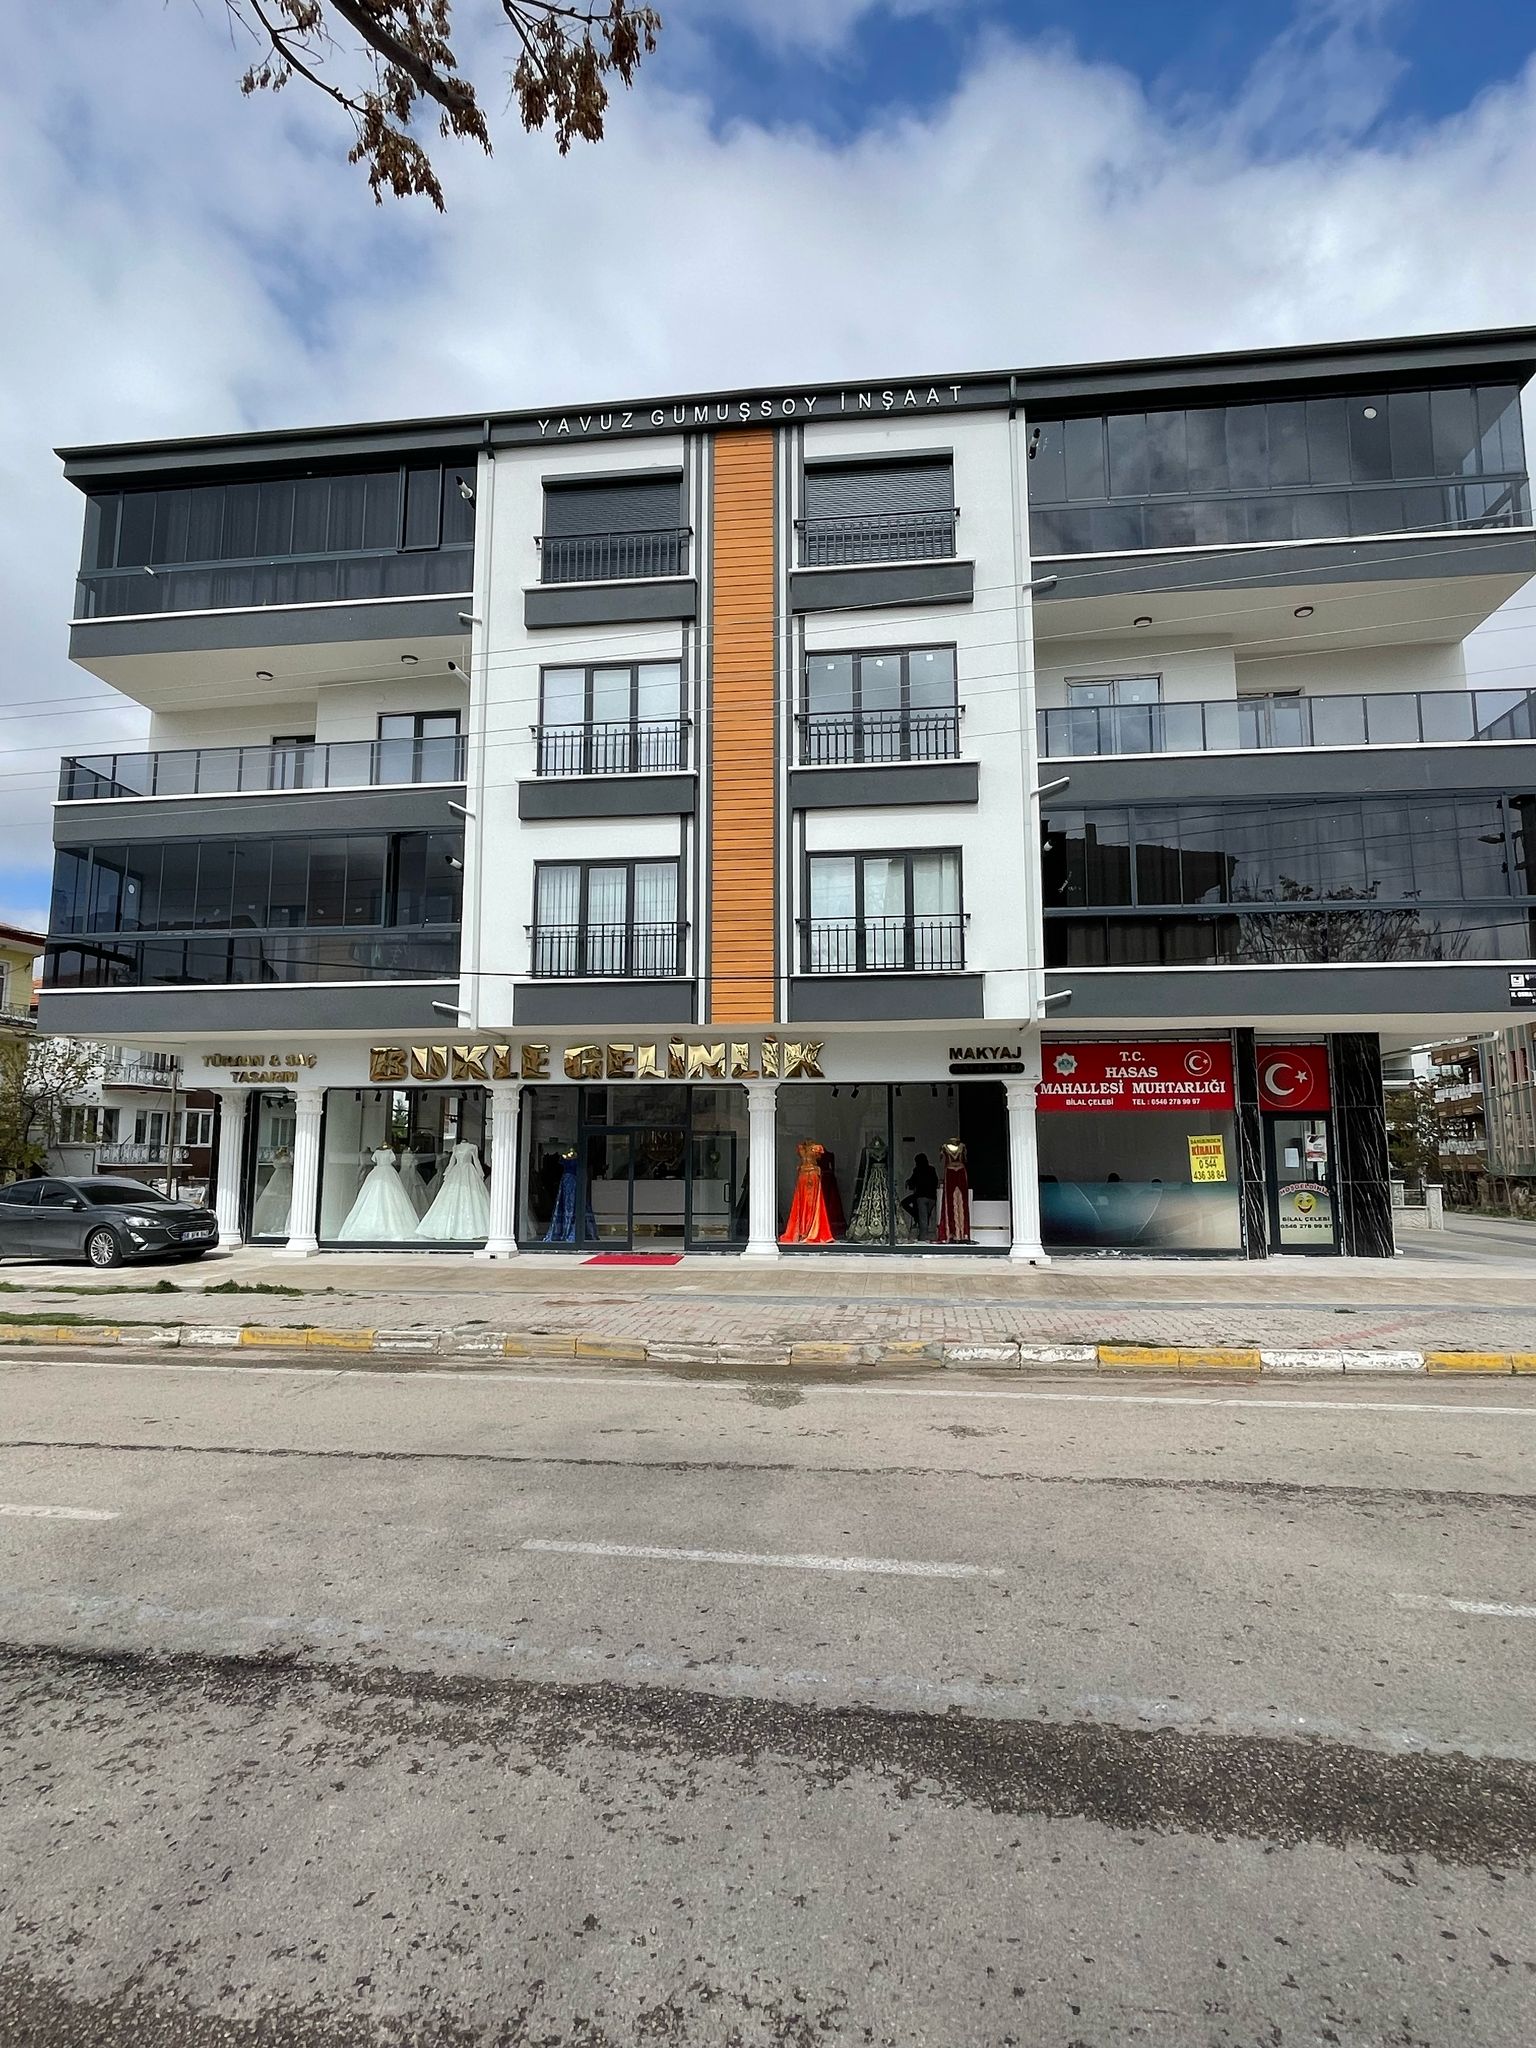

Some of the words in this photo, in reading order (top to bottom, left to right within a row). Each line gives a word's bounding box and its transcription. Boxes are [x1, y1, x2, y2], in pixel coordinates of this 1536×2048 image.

[538, 412, 633, 435] YAVUZ
[839, 386, 962, 411] İNŞAAT
[369, 1044, 551, 1082] BUKLE
[563, 1034, 825, 1080] GELİNLİK
[949, 1046, 1022, 1060] MAKYAJ
[1119, 1051, 1146, 1062] T.C.
[269, 1055, 281, 1066] &
[285, 1053, 318, 1069] SAÇ
[230, 1071, 298, 1083] TASARIM
[1105, 1066, 1158, 1078] HASAS
[1040, 1079, 1125, 1095] MAHALLESİ
[1132, 1078, 1226, 1094] MUHTARLIĞI
[1065, 1097, 1087, 1106] BİLAL
[1087, 1097, 1114, 1107] ÇELEBİ
[1132, 1098, 1146, 1106] TEL
[1191, 1144, 1222, 1156] KİRALIK
[1198, 1159, 1204, 1169] 0
[1204, 1158, 1217, 1169] 544
[1207, 1170, 1216, 1180] 38
